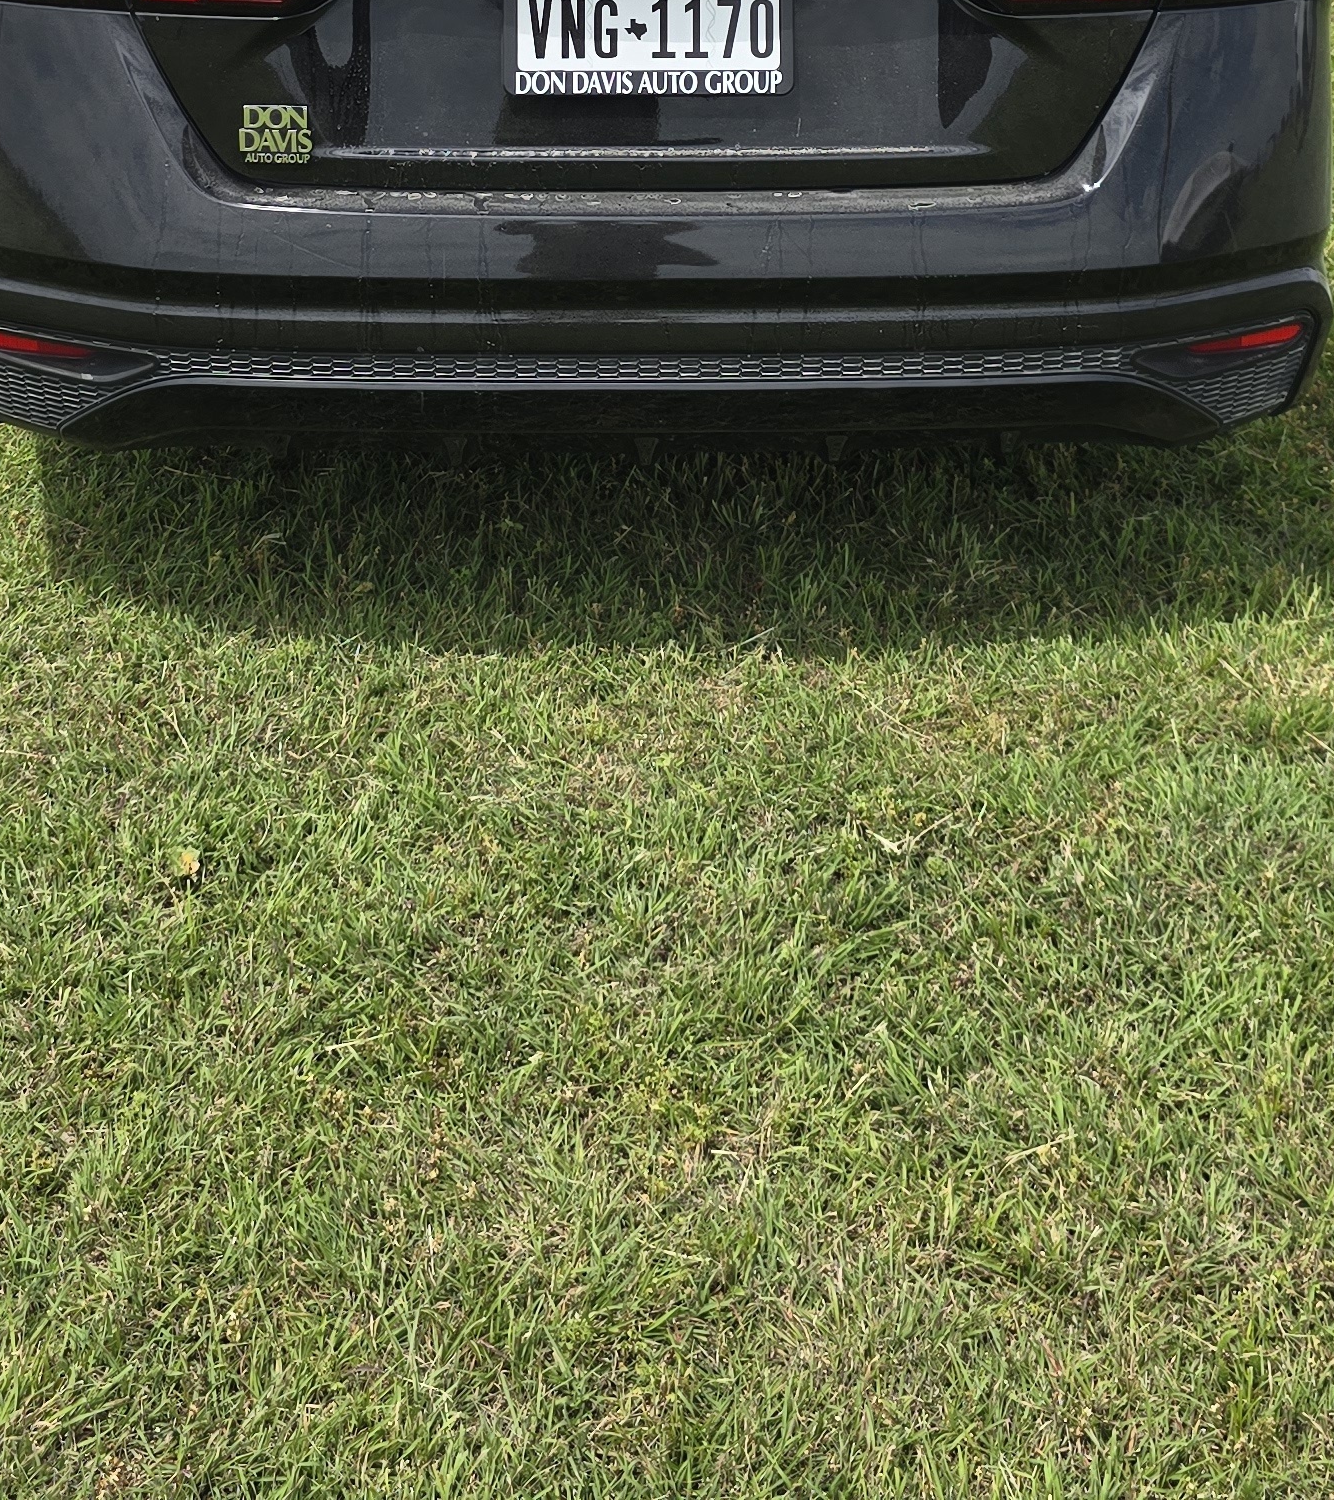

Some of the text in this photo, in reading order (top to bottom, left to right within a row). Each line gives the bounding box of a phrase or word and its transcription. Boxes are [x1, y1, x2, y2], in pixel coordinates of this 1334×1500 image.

[515, 71, 783, 95] DON DAVIS AUTO GROUP
[243, 104, 308, 129] DON
[238, 128, 313, 153] DAVIS
[245, 152, 311, 164] AUTO GROUP
